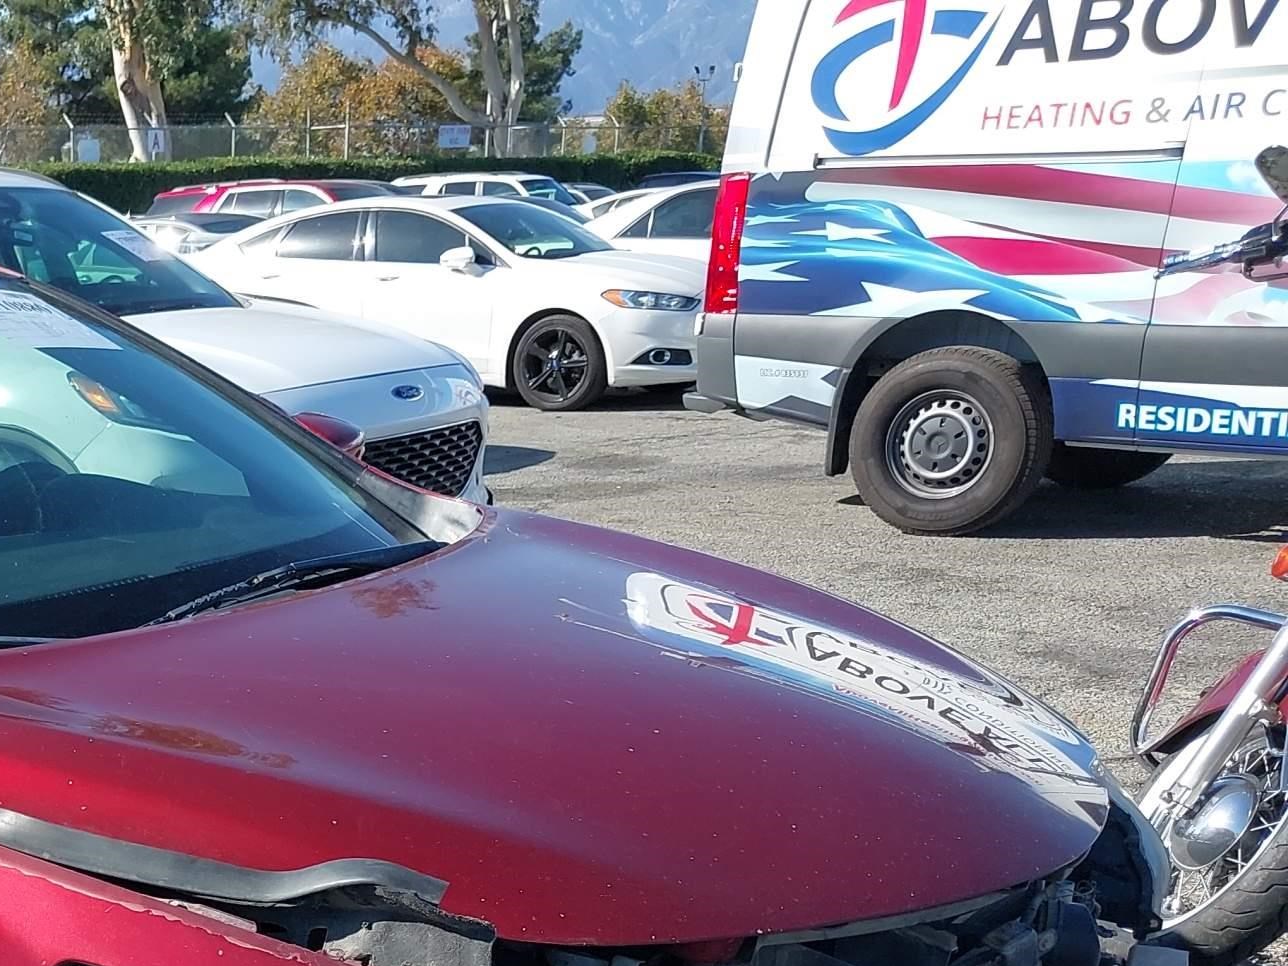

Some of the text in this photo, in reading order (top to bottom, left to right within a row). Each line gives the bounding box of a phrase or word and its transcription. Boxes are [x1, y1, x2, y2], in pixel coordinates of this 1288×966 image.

[996, 0, 1280, 66] ABOV
[980, 99, 1133, 130] HEATING
[1145, 97, 1171, 124] &
[1182, 92, 1247, 122] AIR
[152, 131, 160, 150] A
